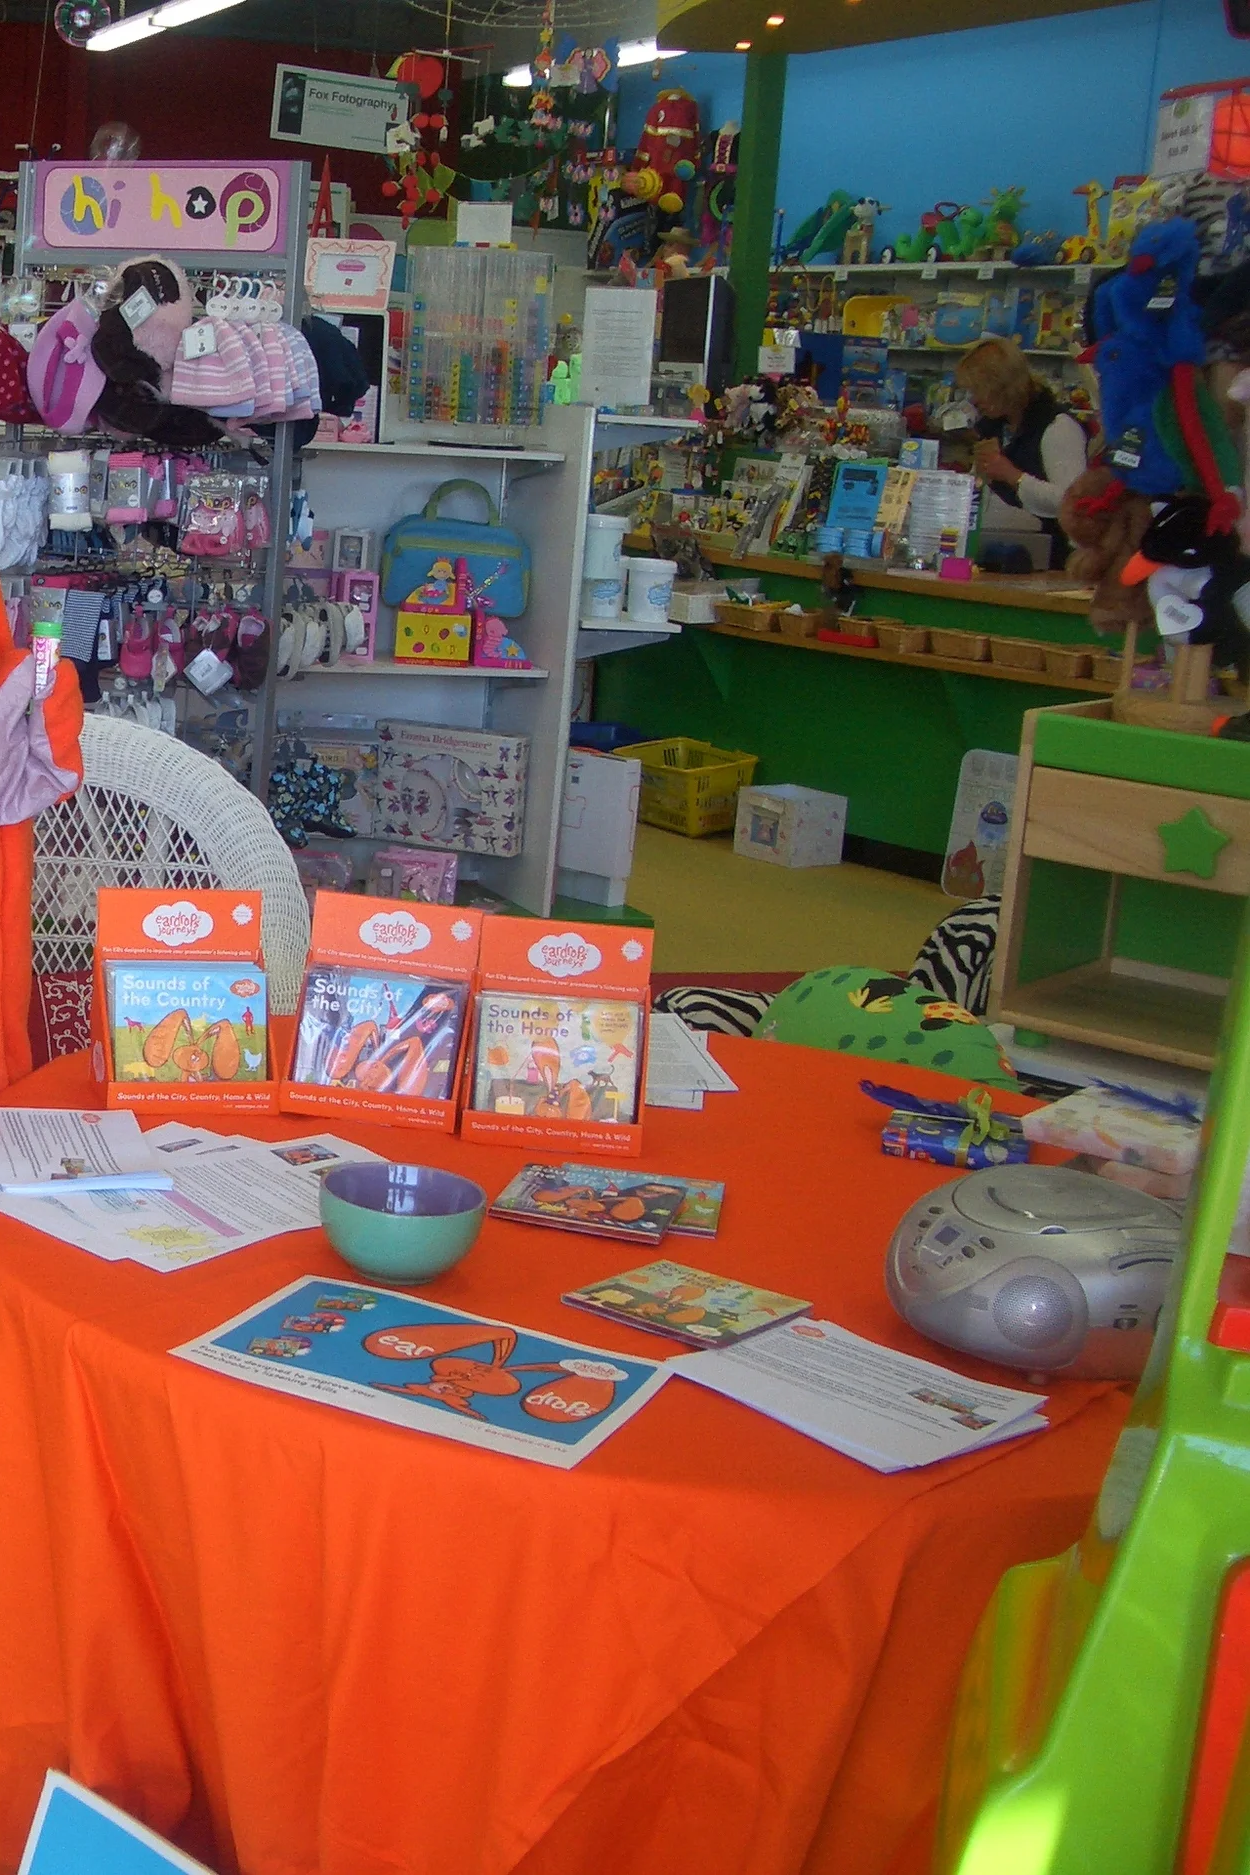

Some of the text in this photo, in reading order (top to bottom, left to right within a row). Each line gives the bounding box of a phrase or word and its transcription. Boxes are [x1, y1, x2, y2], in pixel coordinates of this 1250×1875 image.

[308, 88, 329, 101] Fox
[331, 91, 397, 111] Fotography
[71, 172, 266, 248] hi hop
[401, 730, 431, 743] Emma
[155, 911, 200, 928] eardrops
[157, 924, 197, 937] journeys
[372, 921, 417, 940] eardrops
[374, 933, 414, 947] journeys
[541, 942, 588, 960] eardrops
[542, 956, 585, 969] journeys
[122, 975, 210, 991] Sounds of
[313, 978, 403, 1001] Sounds of
[122, 993, 226, 1010] the Country
[312, 995, 383, 1017] the City
[489, 1004, 574, 1022] Sounds of
[487, 1021, 569, 1038] the Home
[117, 1092, 270, 1102] Sounds of the City, Country, Home & Wild
[289, 1091, 317, 1102] Sounds
[328, 1097, 342, 1105] the
[362, 1101, 394, 1112] Country,
[396, 1105, 418, 1115] Home
[419, 1107, 427, 1115] &
[428, 1109, 445, 1118] Wild
[471, 1121, 500, 1131] Sounds
[501, 1124, 510, 1132] of
[511, 1125, 525, 1133] the
[545, 1128, 579, 1139] Country,
[580, 1131, 603, 1140] Home
[604, 1132, 612, 1140] &
[613, 1133, 631, 1142] Wild
[378, 1335, 435, 1356] ear
[199, 1345, 218, 1354] Fun
[220, 1351, 242, 1362] CDs
[244, 1357, 292, 1376] designed
[308, 1376, 350, 1391] improve
[350, 1388, 376, 1399] your
[262, 1370, 308, 1387] listening
[310, 1382, 338, 1395] skills
[525, 1391, 591, 1417] drops
